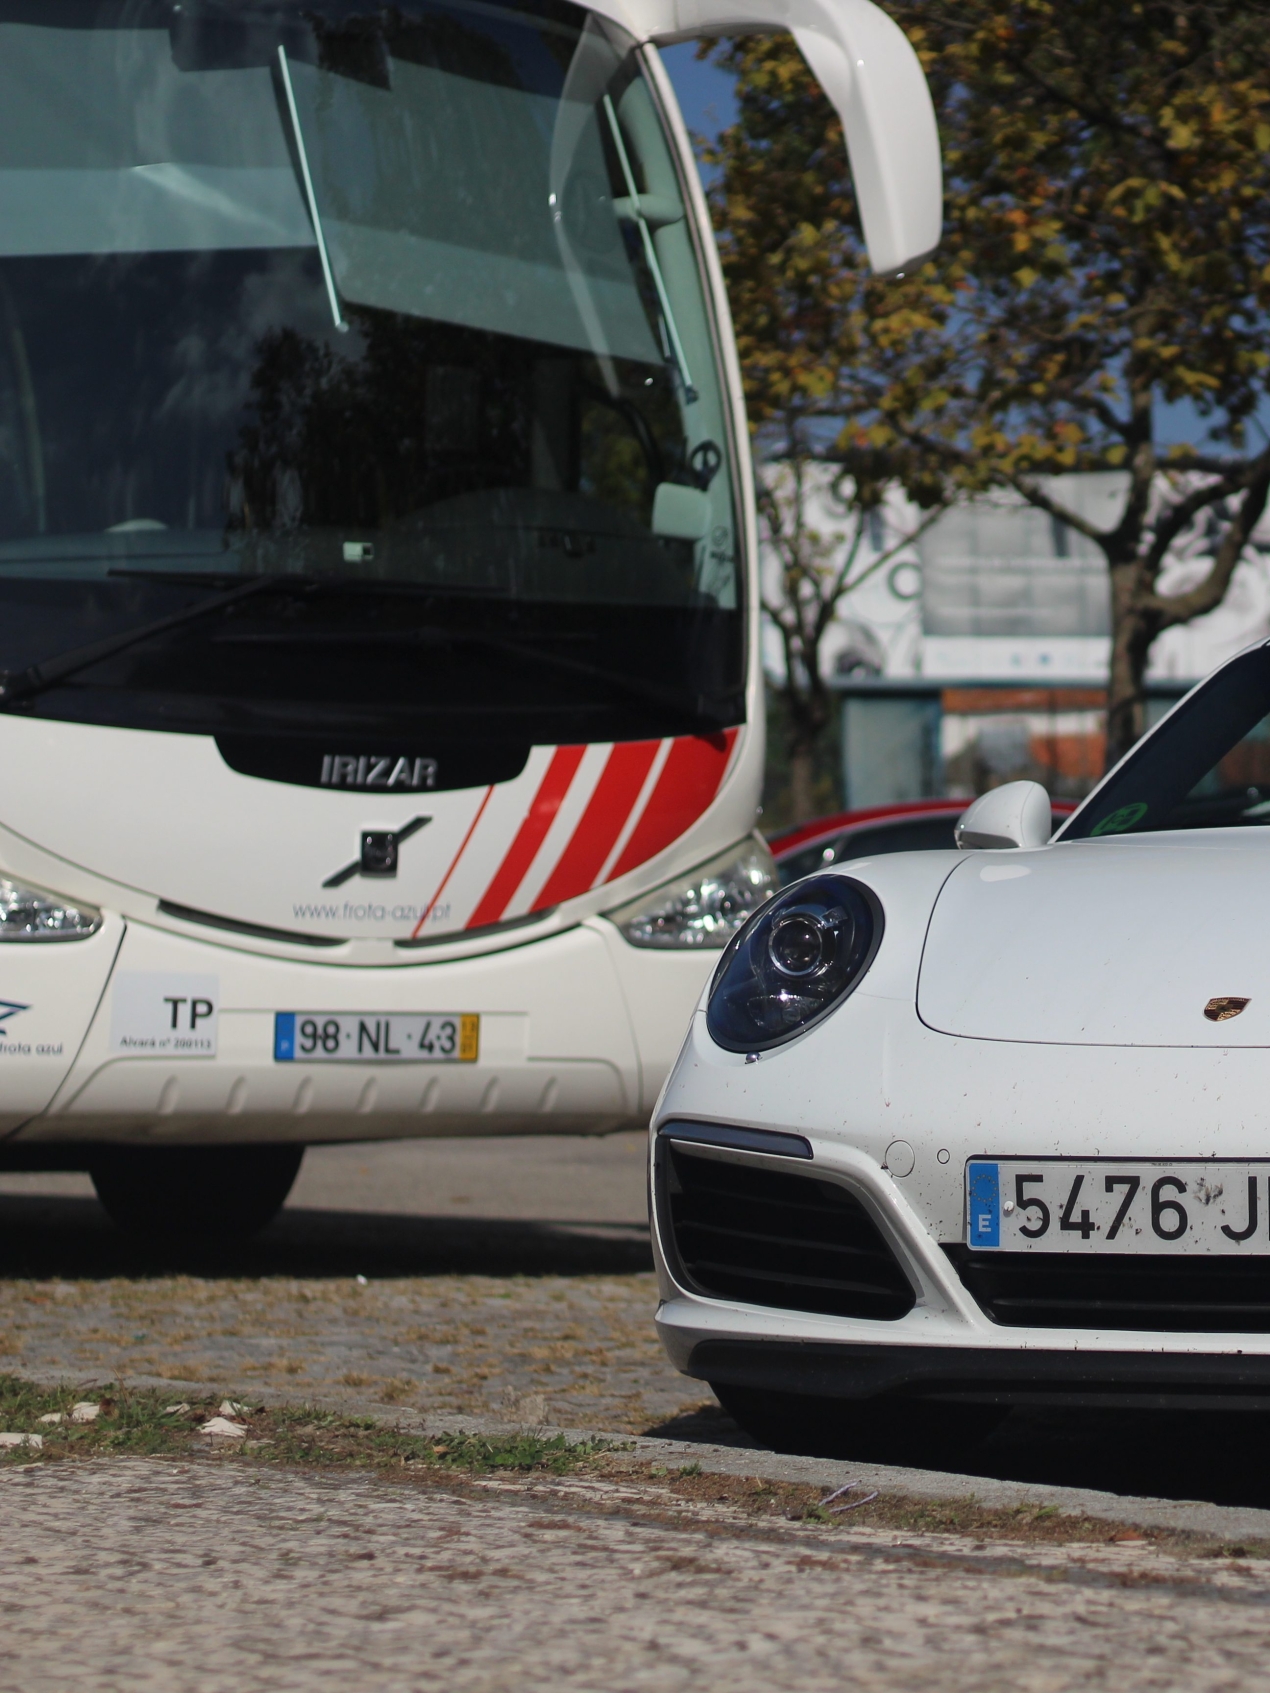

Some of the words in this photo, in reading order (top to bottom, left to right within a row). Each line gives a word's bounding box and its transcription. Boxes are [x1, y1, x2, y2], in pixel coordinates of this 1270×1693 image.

[320, 755, 438, 786] IRIZAR
[164, 996, 214, 1030] TP
[978, 1214, 992, 1232] E
[1014, 1173, 1188, 1241] 5476
